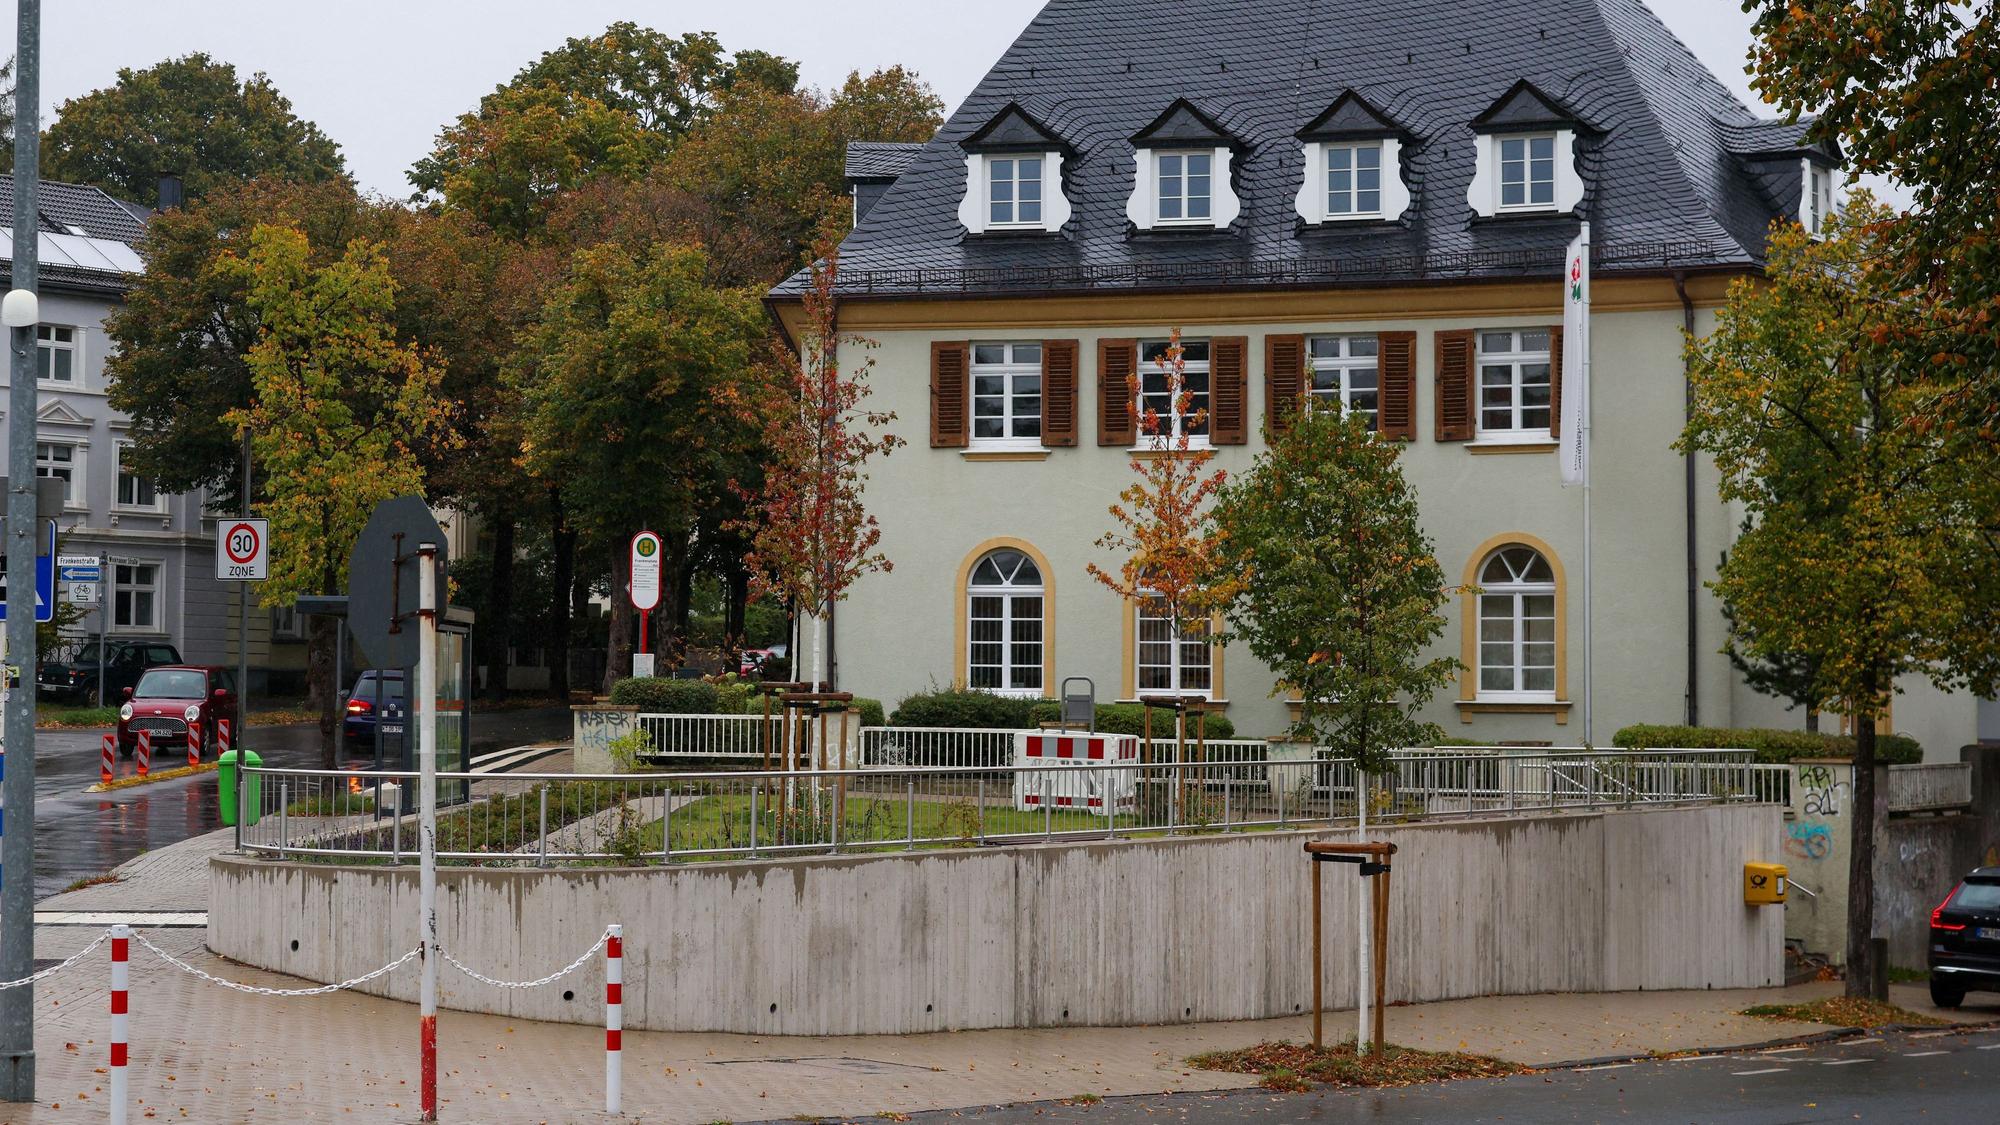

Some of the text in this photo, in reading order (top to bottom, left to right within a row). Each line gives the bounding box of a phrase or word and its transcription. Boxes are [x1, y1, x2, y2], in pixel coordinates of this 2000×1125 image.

[232, 535, 252, 553] 30
[642, 541, 651, 553] H
[60, 557, 96, 565] Frankenstraße
[229, 566, 255, 577] ZONE
